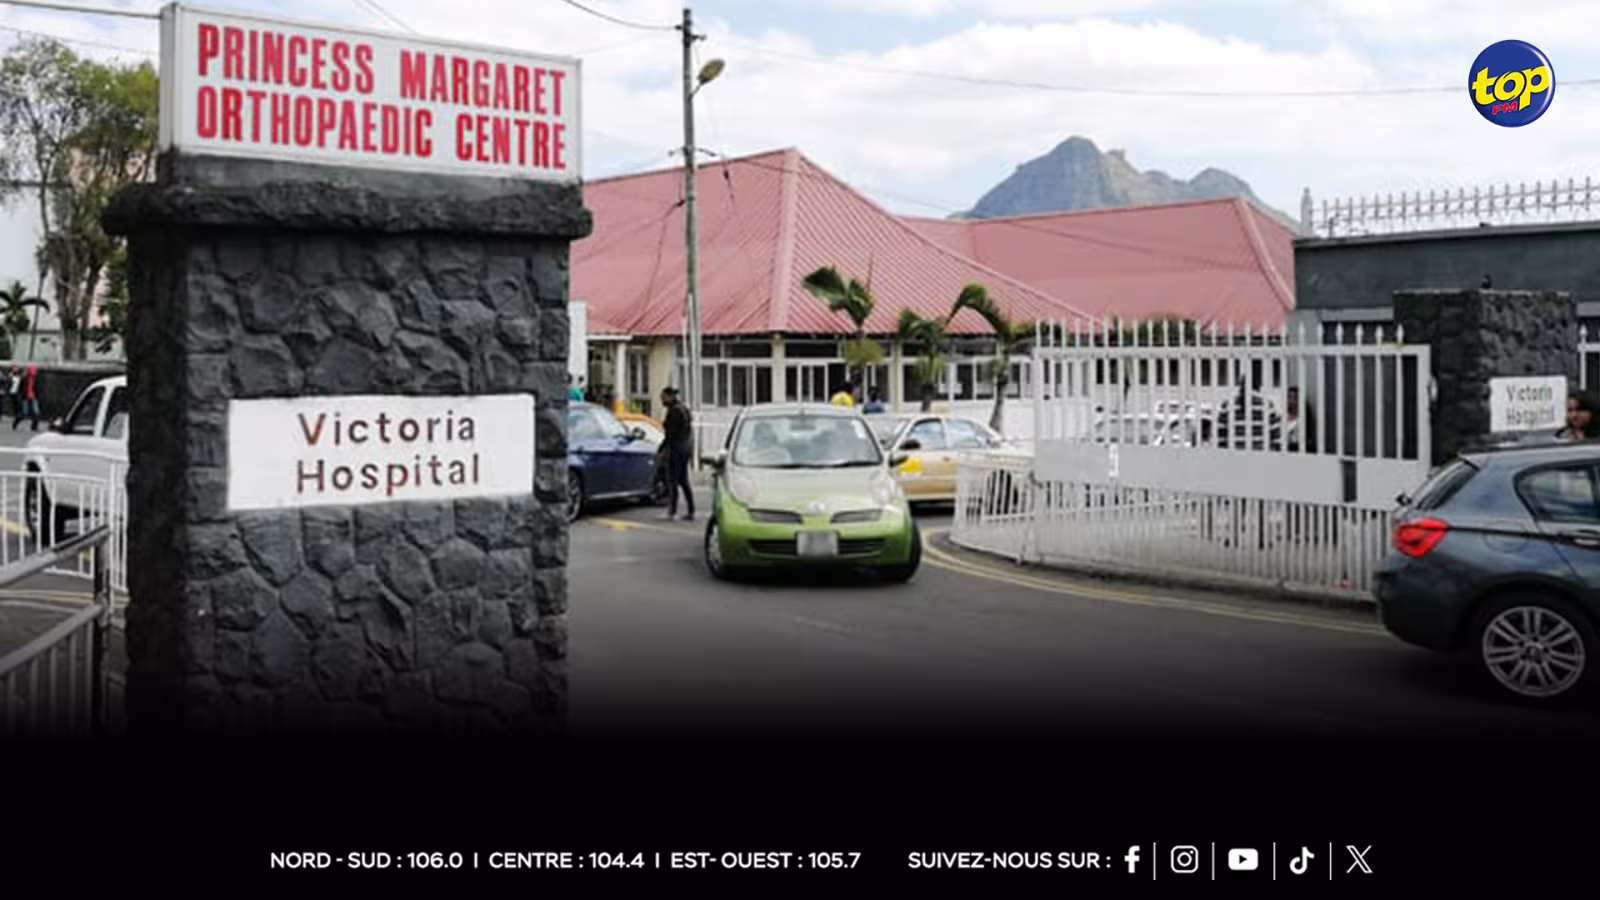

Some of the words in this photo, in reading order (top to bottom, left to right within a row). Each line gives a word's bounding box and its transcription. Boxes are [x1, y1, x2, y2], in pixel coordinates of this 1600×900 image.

[197, 23, 375, 94] PRINCESS
[399, 49, 566, 117] MARGARET
[197, 85, 433, 158] ORTHOPAEDIC
[455, 112, 566, 170] CENTRE
[297, 409, 476, 446] Victoria
[296, 453, 480, 497] Hospital
